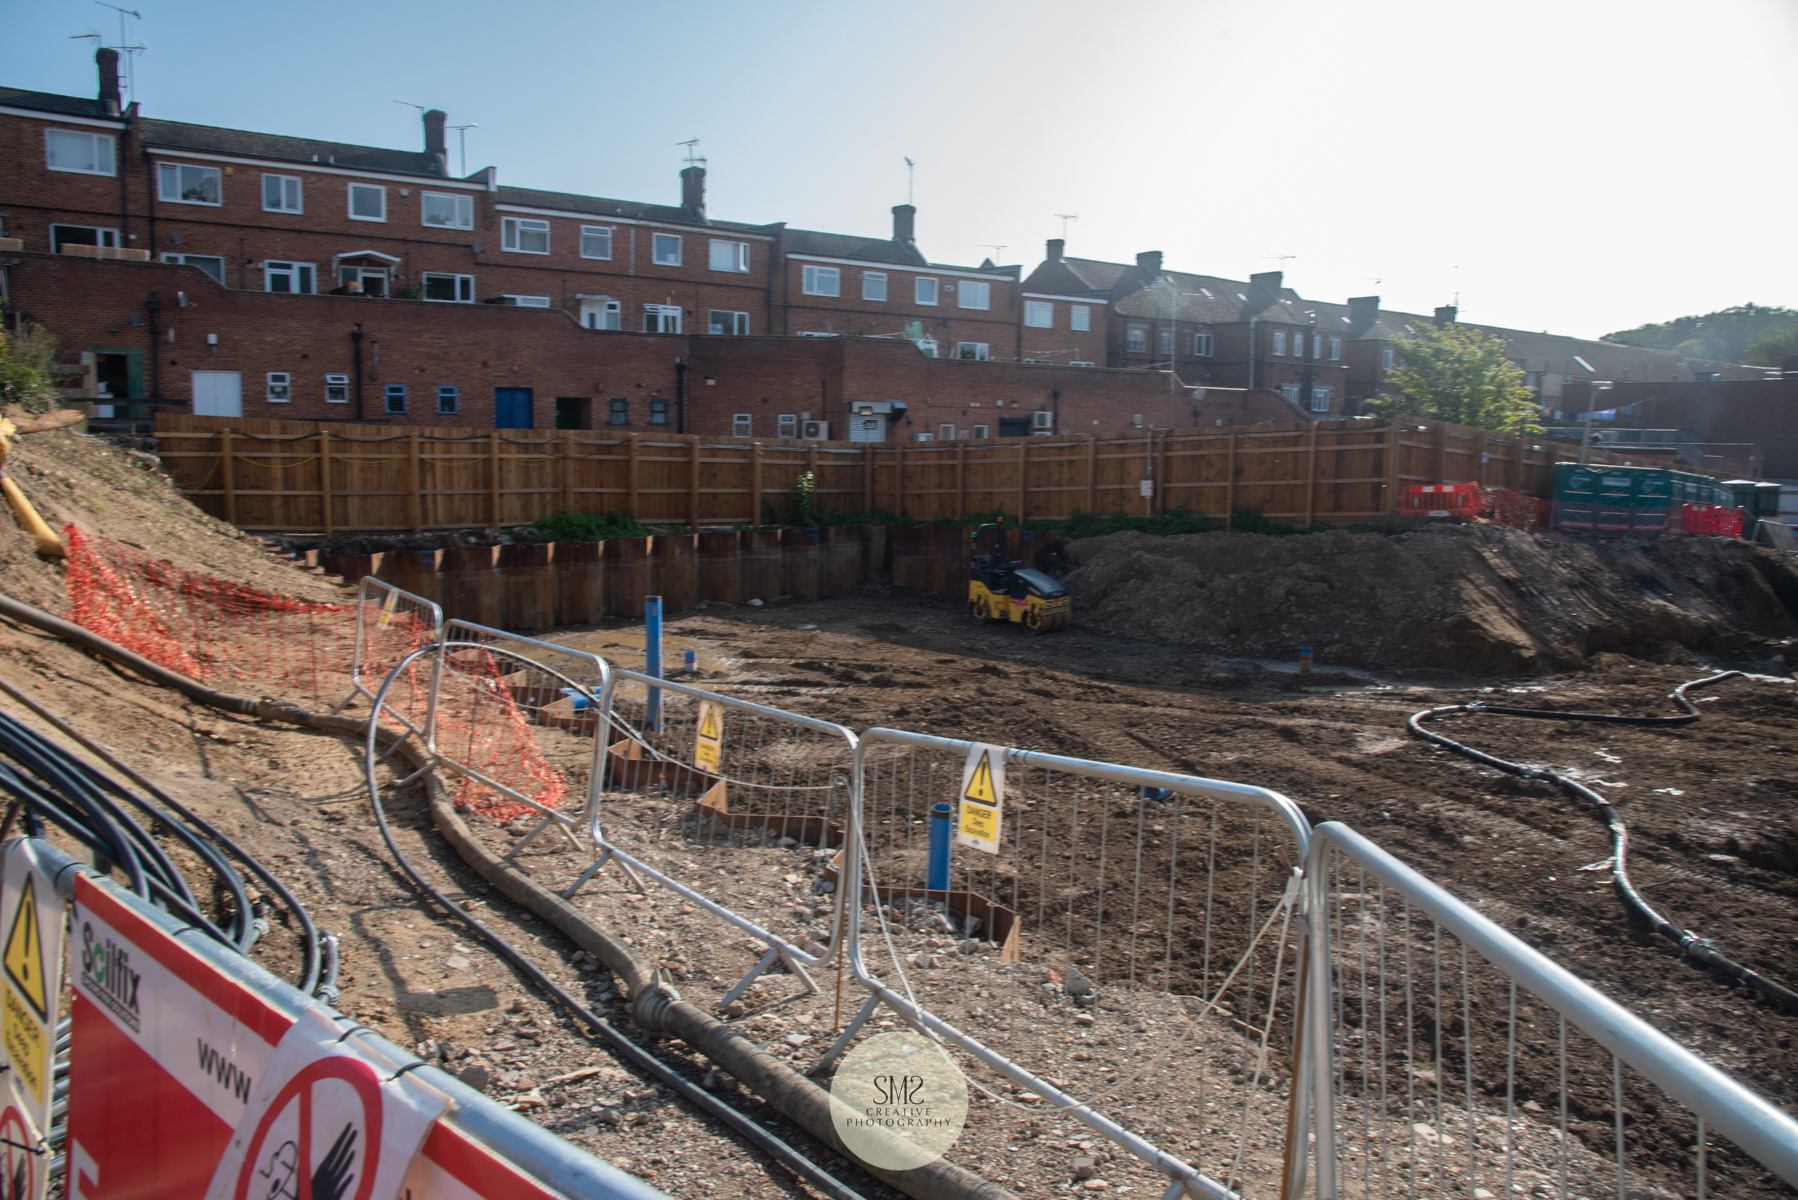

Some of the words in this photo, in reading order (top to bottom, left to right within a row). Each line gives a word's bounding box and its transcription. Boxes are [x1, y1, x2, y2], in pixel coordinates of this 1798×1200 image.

[966, 805, 992, 820] DANGER
[971, 817, 985, 828] Deep
[964, 824, 991, 839] Excavation
[81, 920, 142, 1015] Soilfix
